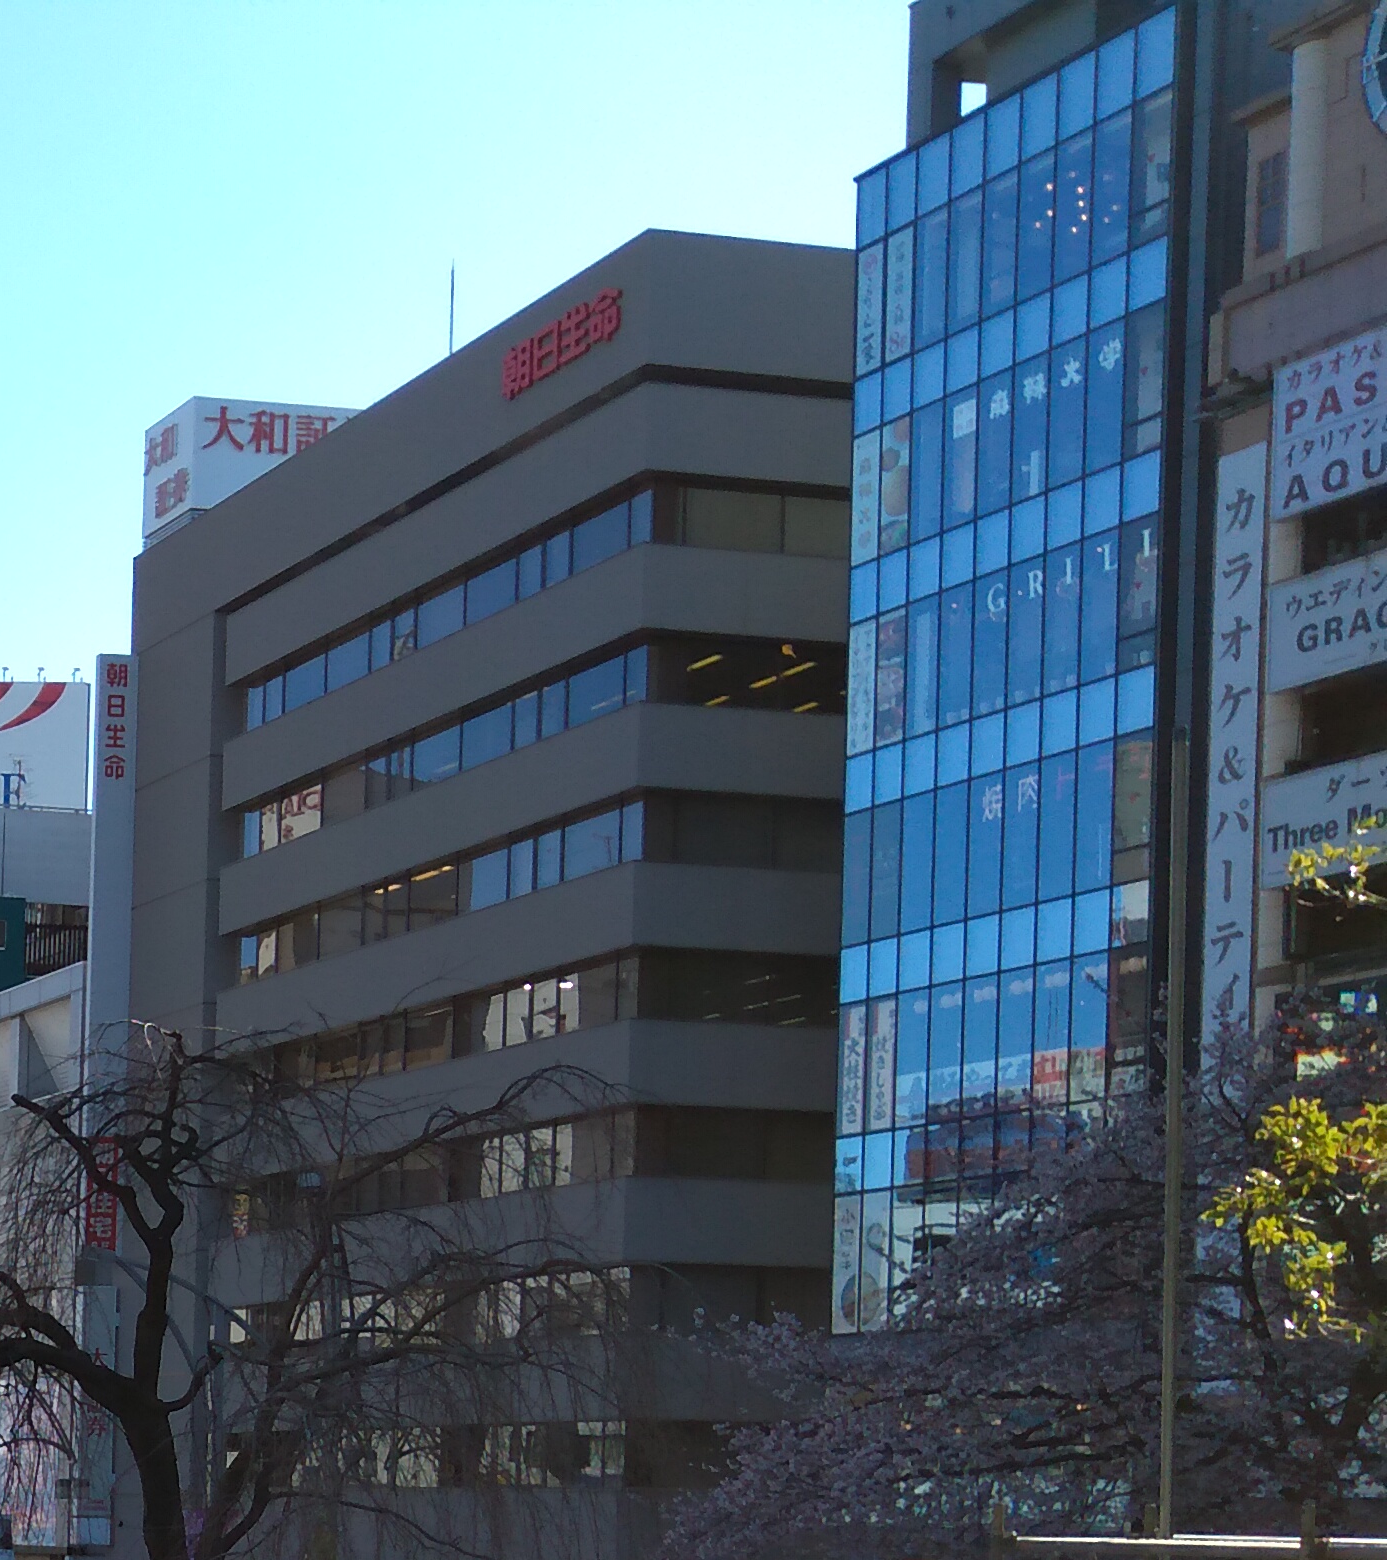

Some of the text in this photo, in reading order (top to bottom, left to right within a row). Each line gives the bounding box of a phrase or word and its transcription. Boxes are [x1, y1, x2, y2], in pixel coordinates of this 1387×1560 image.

[501, 287, 623, 401] 朝日生命
[1284, 370, 1378, 435] PAS
[1282, 441, 1387, 510] AQU
[103, 662, 129, 780] 朝日生命
[1267, 819, 1339, 854] Three
